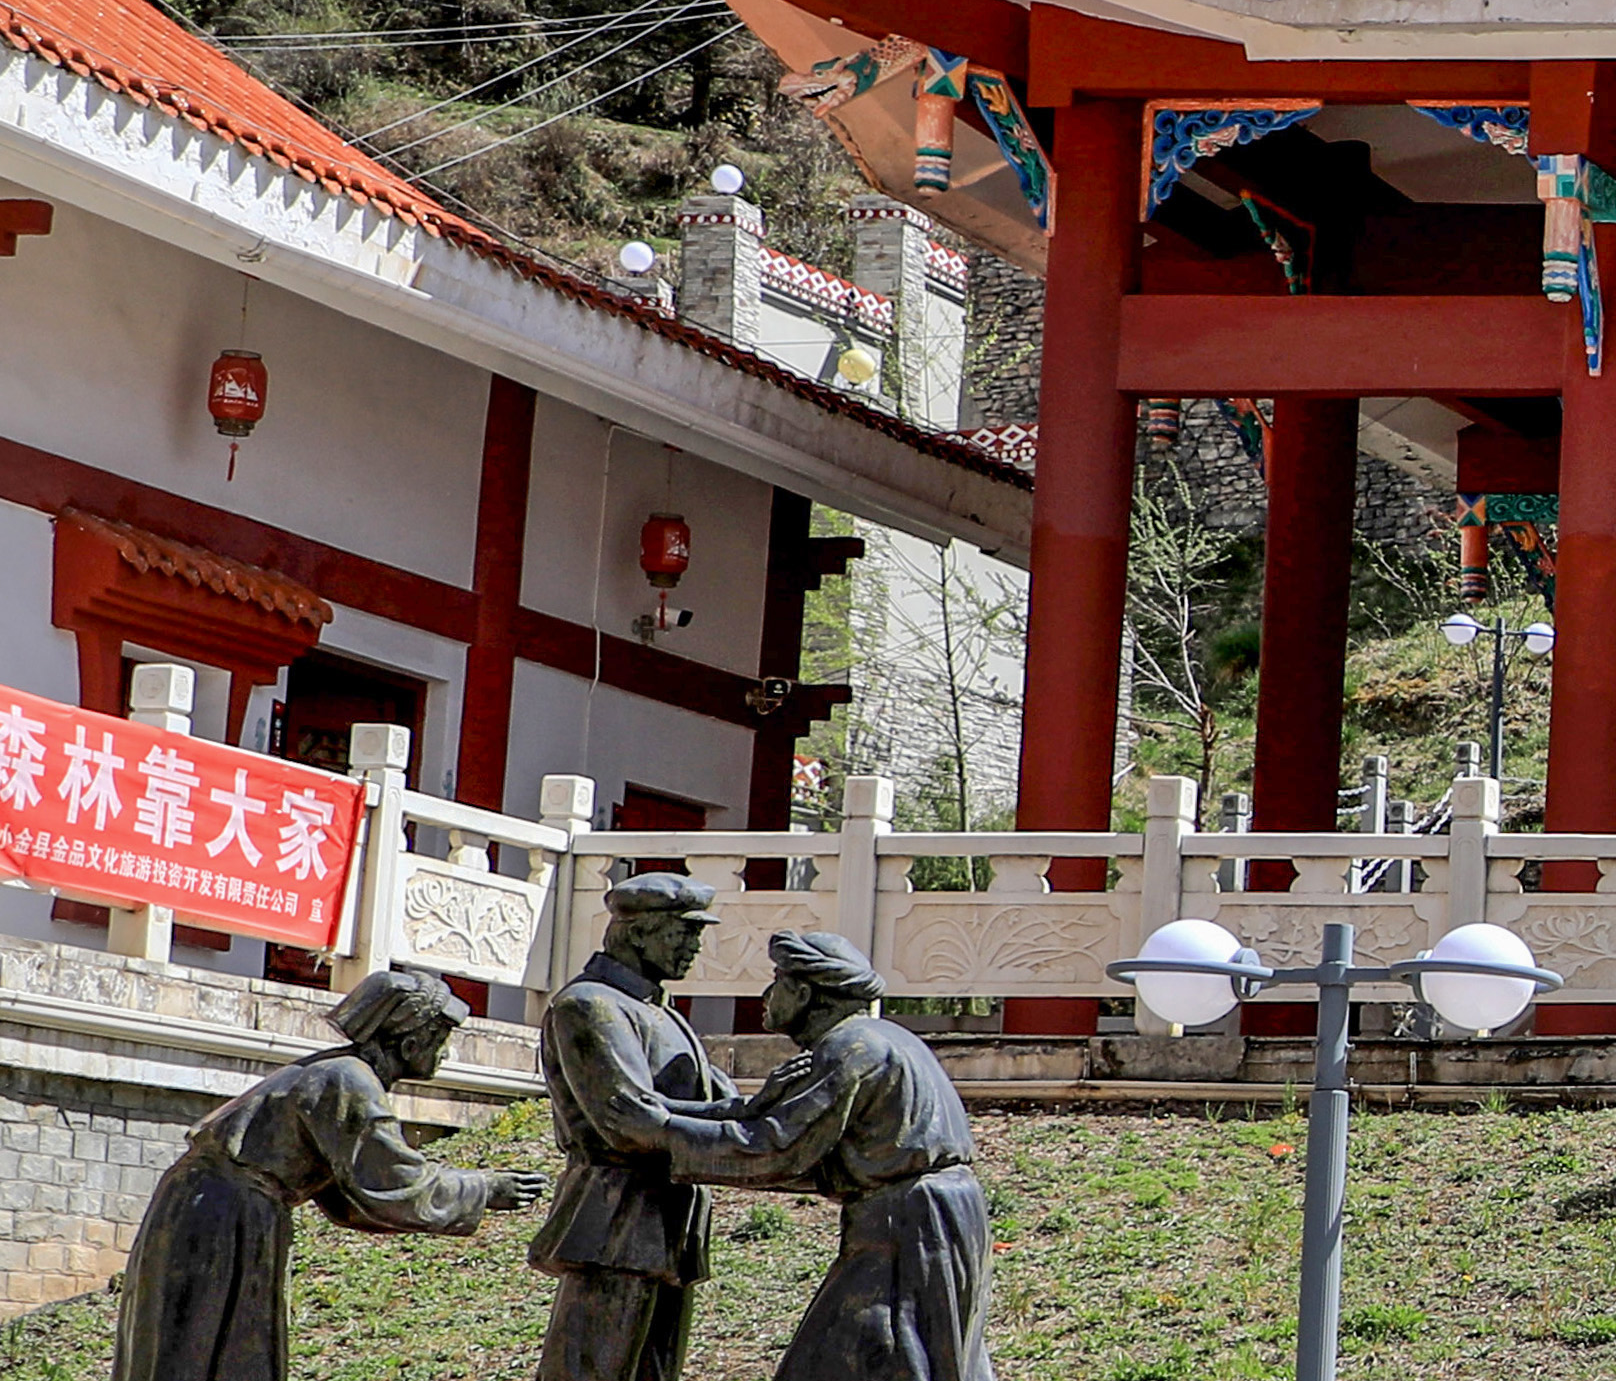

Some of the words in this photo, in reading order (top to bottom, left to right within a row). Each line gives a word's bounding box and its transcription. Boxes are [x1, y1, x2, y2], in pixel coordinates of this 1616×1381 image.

[0, 704, 336, 882] 森林靠大家
[308, 898, 324, 923] 宣
